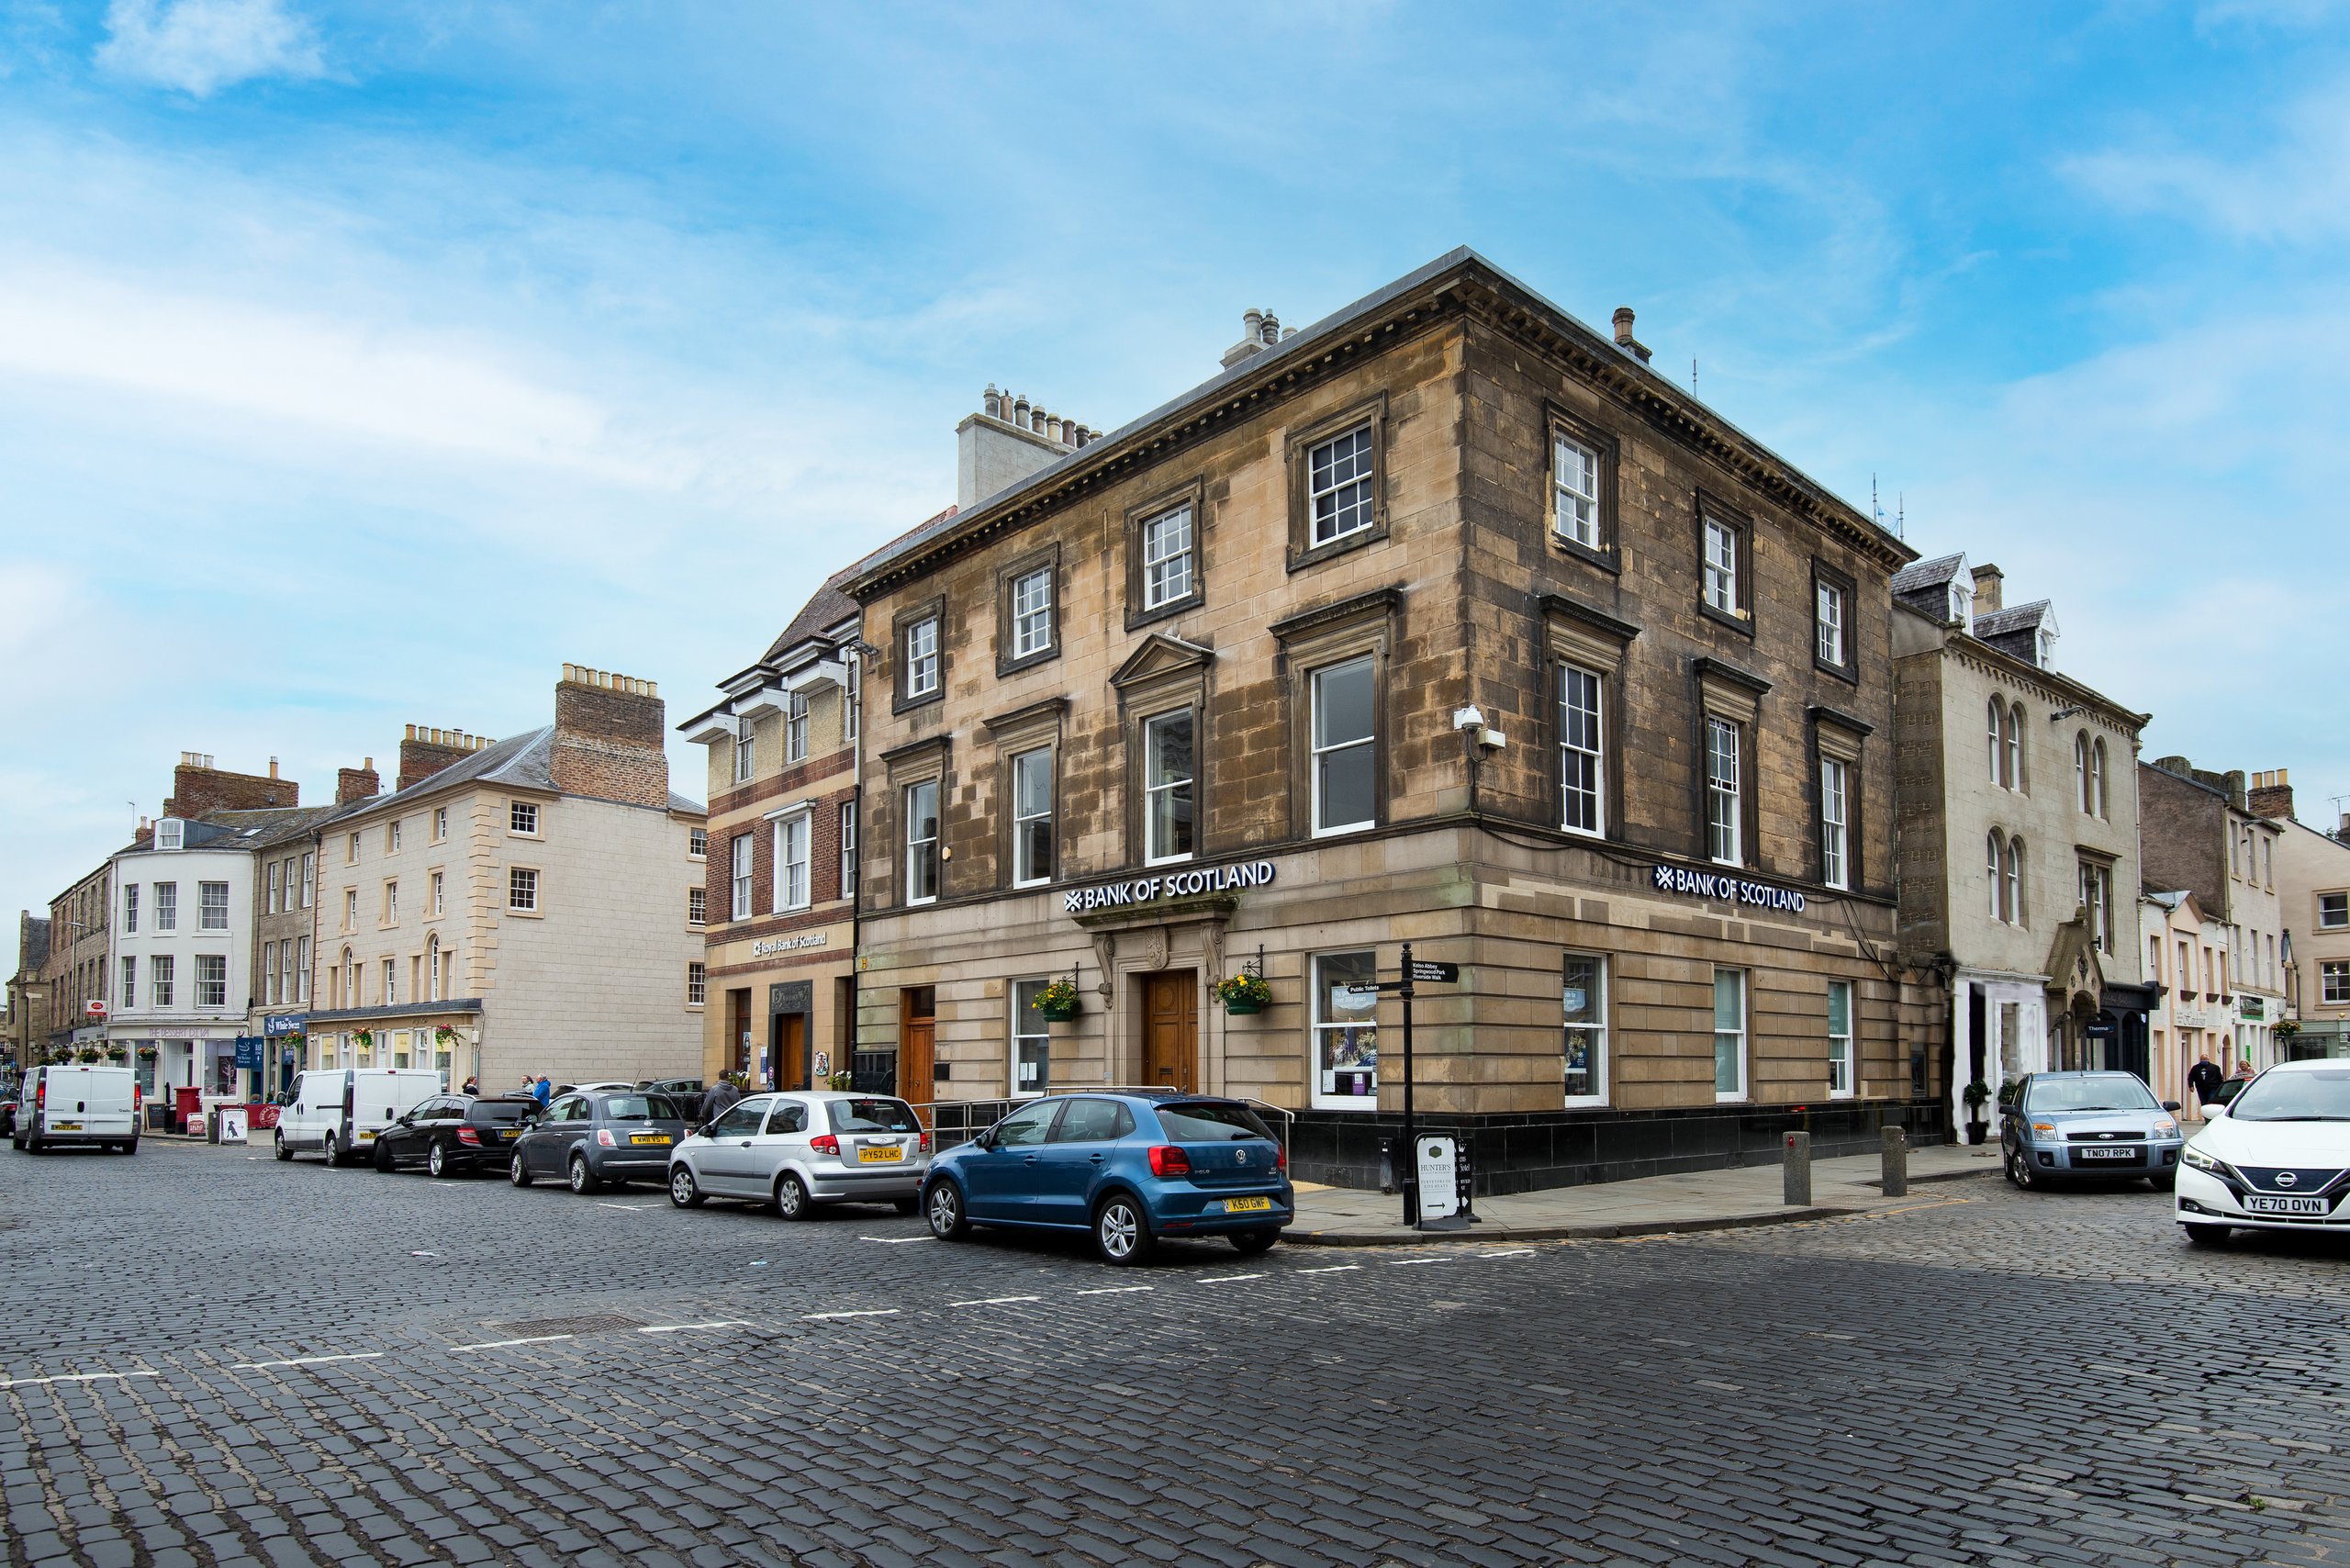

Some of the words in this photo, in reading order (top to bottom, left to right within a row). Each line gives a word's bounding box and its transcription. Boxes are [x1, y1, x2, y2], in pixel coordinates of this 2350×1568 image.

[1085, 882, 1131, 909] BANK
[1135, 879, 1160, 902] OF
[1166, 861, 1274, 897] SCOTLAND
[1676, 869, 1716, 896] BANK
[1718, 877, 1737, 900] OF
[1740, 881, 1805, 913] SCOTLAND
[761, 940, 778, 956] Royal
[778, 938, 791, 951] Bank
[791, 936, 800, 948] of
[800, 932, 826, 947] Scotland
[149, 1028, 160, 1037] THE
[161, 1028, 187, 1037] DESSERT
[189, 1028, 209, 1037] DIVA
[884, 1150, 899, 1159] LHC
[2112, 1148, 2132, 1157] RPK
[1420, 1163, 1451, 1171] HUNTER'S
[1233, 1199, 1249, 1209] K50
[1250, 1198, 1265, 1208] GWF
[2250, 1197, 2288, 1211] YE70
[2292, 1199, 2322, 1212] OVN
